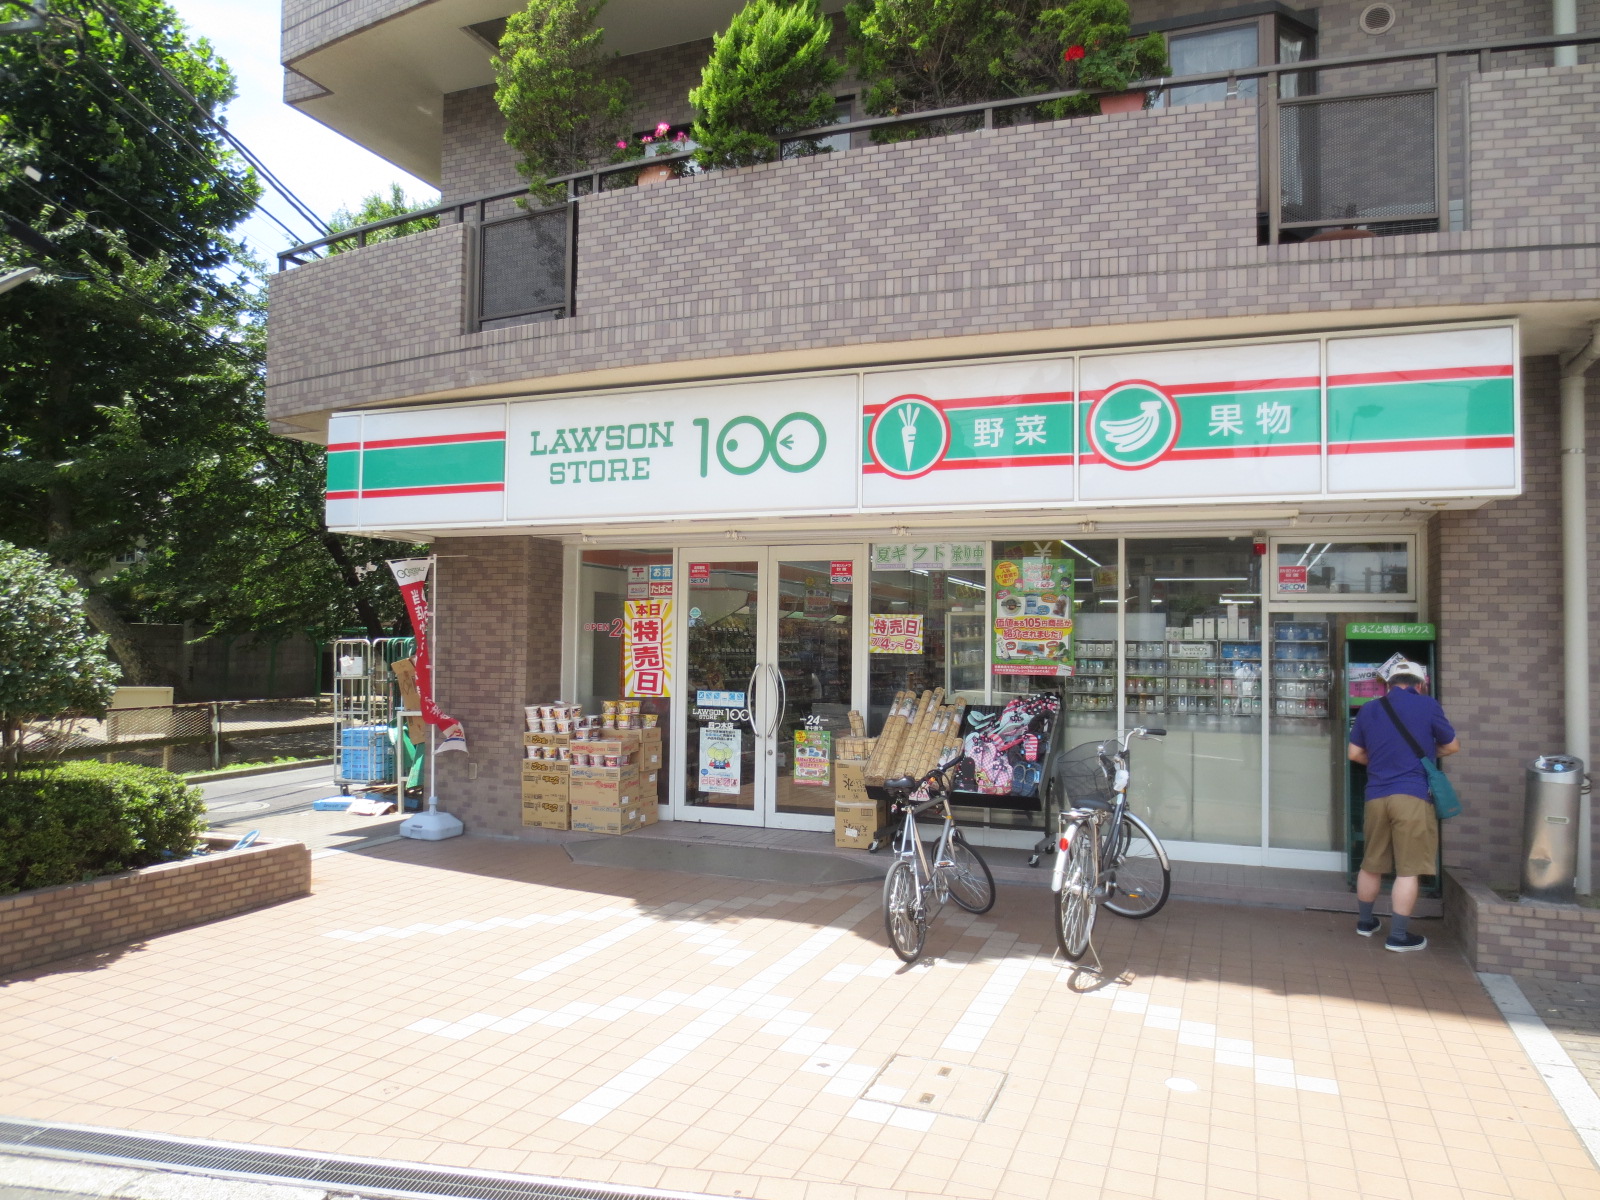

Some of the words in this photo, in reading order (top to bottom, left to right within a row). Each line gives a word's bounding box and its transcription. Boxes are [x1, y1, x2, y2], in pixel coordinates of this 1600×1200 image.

[1209, 401, 1291, 437] 果物
[974, 415, 1047, 448] 野菜
[530, 421, 674, 456] LAWSON
[693, 412, 827, 477] 100
[550, 457, 650, 485] STORE
[653, 568, 671, 577] お酒
[651, 585, 672, 594] たばこ
[636, 604, 661, 616] 本日
[584, 623, 610, 631] OPEN
[610, 618, 625, 637] 2
[874, 619, 919, 634] 特売日
[1352, 625, 1429, 634] まるごと情報ボックス
[633, 620, 660, 692] 特売日
[692, 708, 724, 716] LAWSON
[725, 709, 750, 721] 100
[806, 715, 820, 725] 24
